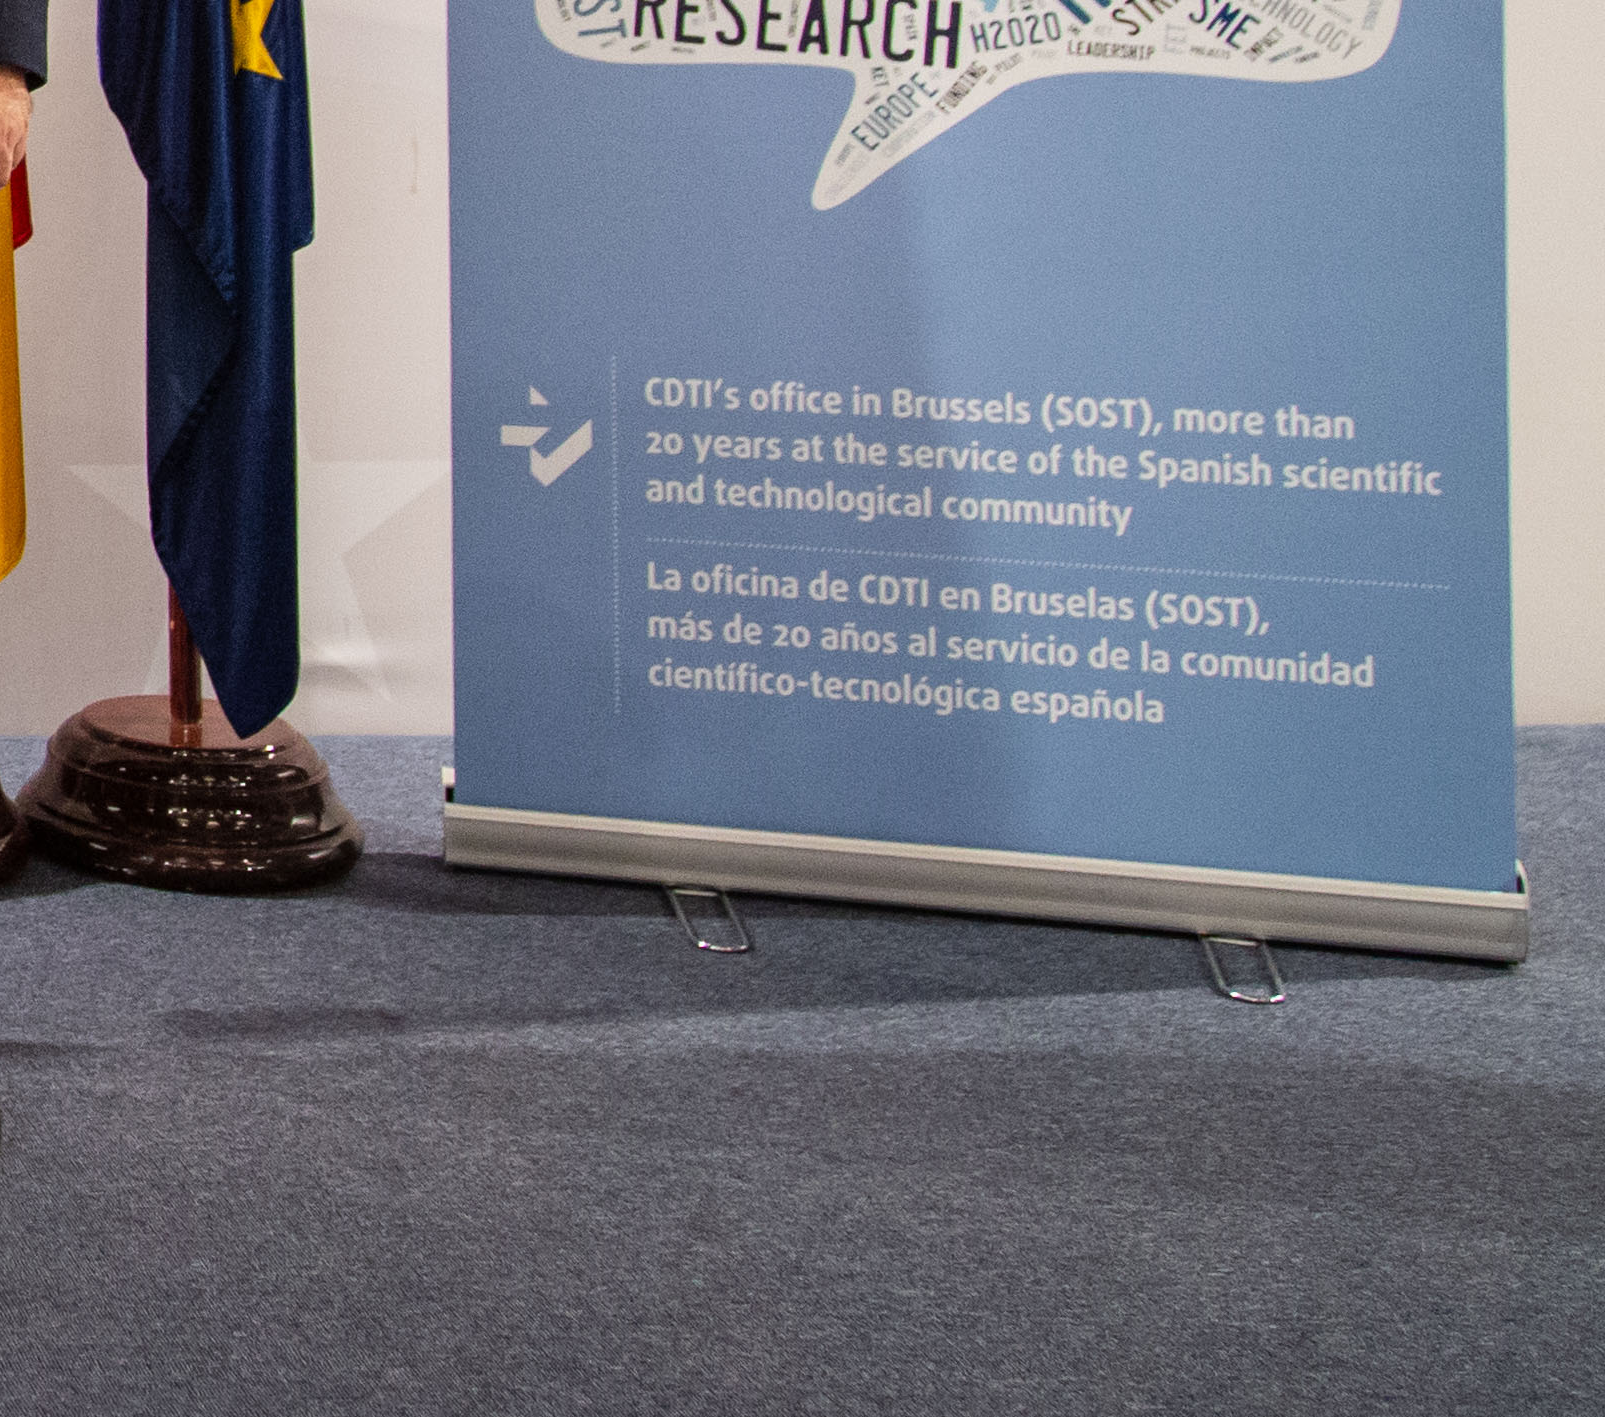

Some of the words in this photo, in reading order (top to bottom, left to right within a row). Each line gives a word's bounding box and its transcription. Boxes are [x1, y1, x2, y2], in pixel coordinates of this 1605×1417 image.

[645, 377, 740, 410] CDTI's
[750, 381, 842, 414] office
[853, 385, 881, 415] in
[892, 388, 1031, 424] Brussels
[1042, 393, 1162, 436] (SOST),
[1174, 408, 1264, 435] more
[1275, 405, 1355, 439] than
[647, 431, 683, 455] 20
[693, 435, 782, 463] years
[792, 436, 823, 462] at
[833, 433, 887, 466] the
[898, 441, 1018, 473] service
[1028, 444, 1062, 475] of
[1073, 445, 1128, 479] the
[1139, 450, 1272, 489] Spanish
[1283, 458, 1442, 496] scientific
[646, 474, 704, 504] and
[714, 478, 932, 522] technological
[942, 496, 1133, 537] community
[648, 561, 682, 591] La
[692, 563, 799, 598] oficina
[809, 570, 849, 602] de
[859, 574, 929, 607] CDTI
[940, 587, 980, 611] en
[991, 582, 1134, 620] Bruselas
[1145, 590, 1269, 635] (SOST),
[648, 611, 713, 641] más
[723, 613, 762, 645] de
[774, 625, 811, 648] 20
[821, 623, 898, 654] años
[908, 626, 936, 656] al
[948, 633, 1078, 667] servicio
[1089, 638, 1130, 670] de
[1142, 641, 1170, 673] la
[1181, 651, 1375, 688] comunidad
[648, 658, 1000, 716] científico-tecnológica
[1011, 689, 1164, 724] española
